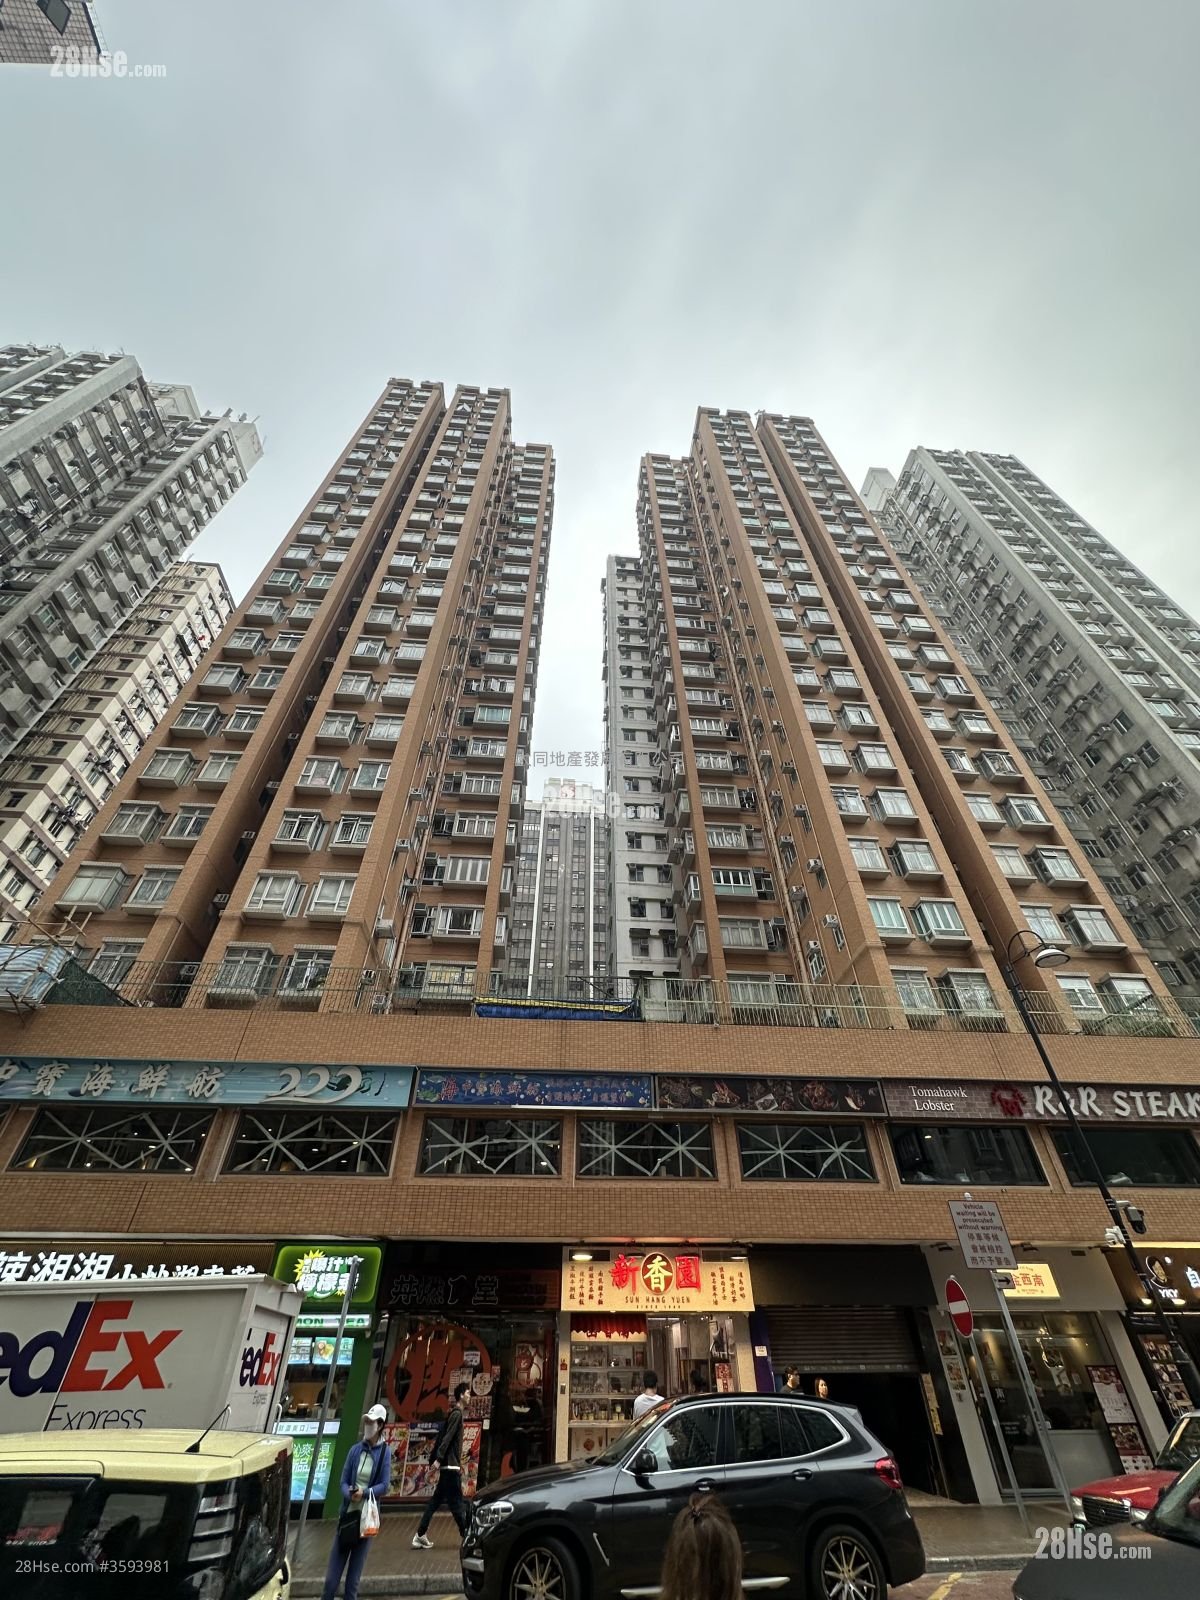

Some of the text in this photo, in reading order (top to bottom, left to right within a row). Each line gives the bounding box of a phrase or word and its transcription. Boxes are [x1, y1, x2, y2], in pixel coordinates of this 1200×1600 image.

[908, 1085, 968, 1098] Tomahawk
[913, 1099, 955, 1111] Lobster
[1033, 1085, 1104, 1116] R&R
[611, 1254, 701, 1295] 新香園
[625, 1296, 691, 1304] SUN HANG YUEN
[1158, 1288, 1179, 1299] YKY
[43, 1405, 147, 1431] Express
